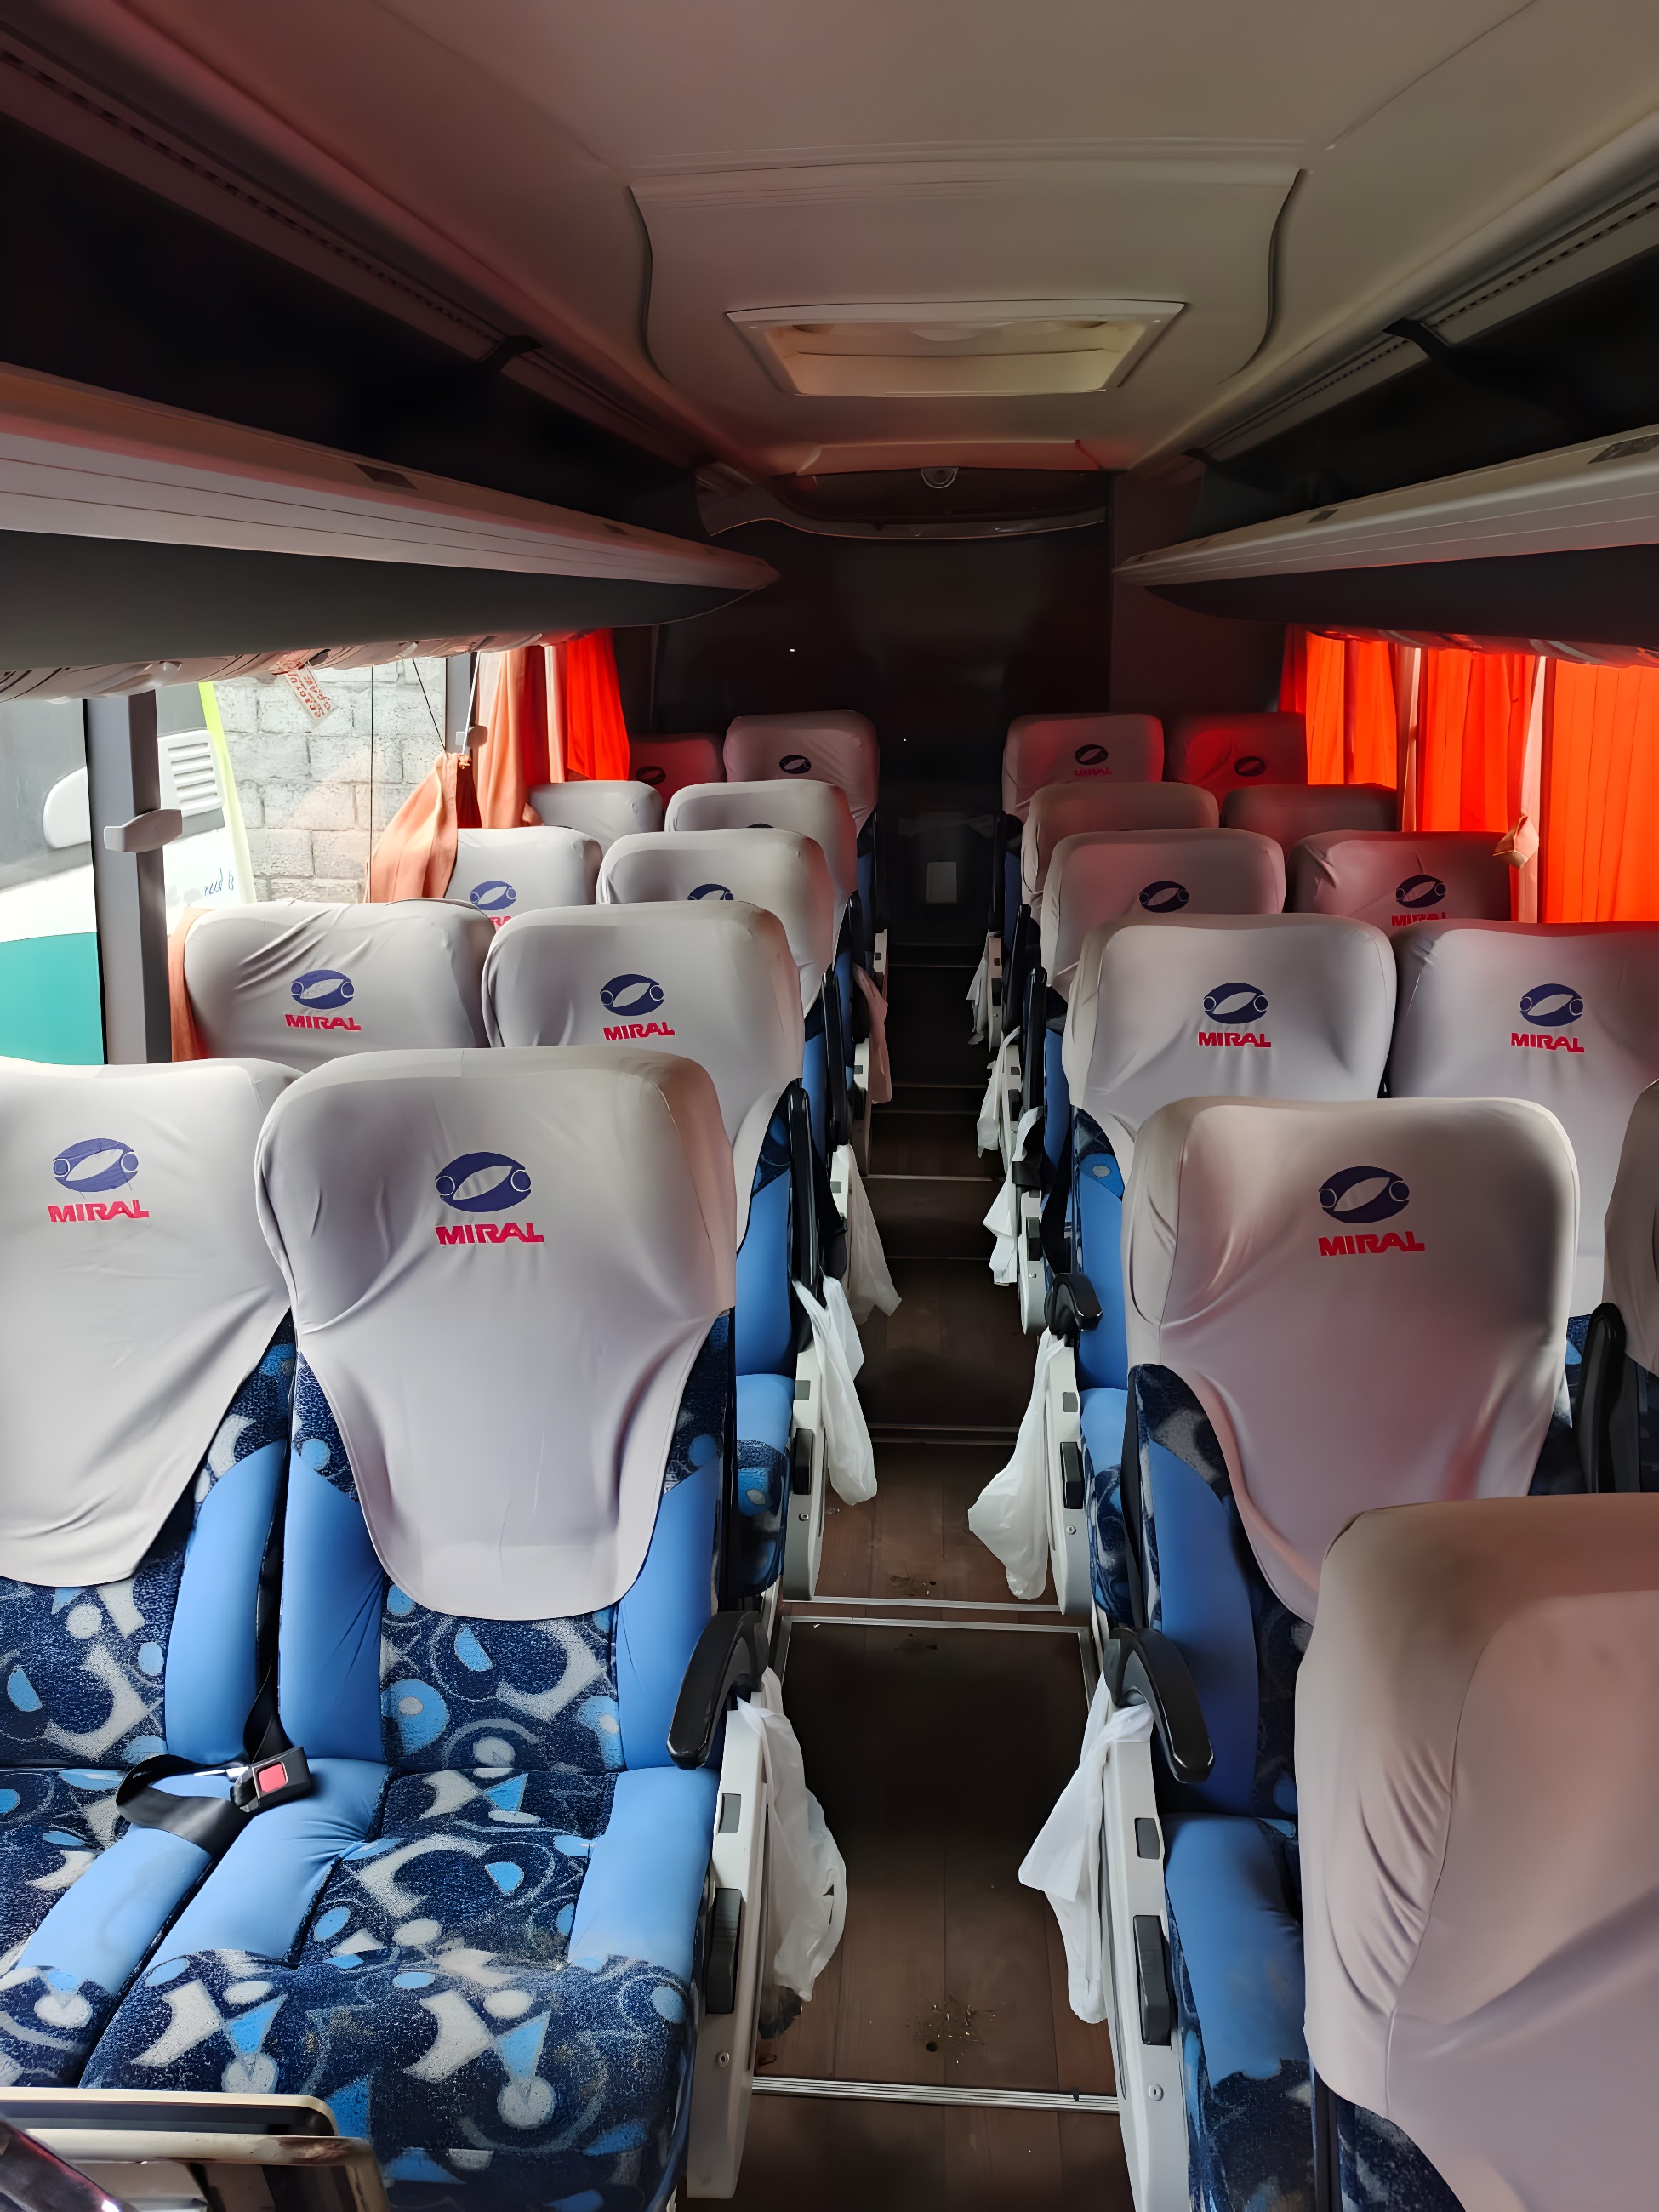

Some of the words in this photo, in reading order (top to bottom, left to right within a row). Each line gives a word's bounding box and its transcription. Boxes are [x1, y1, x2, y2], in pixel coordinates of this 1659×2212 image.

[285, 1013, 362, 1031] MIRAL
[603, 1021, 676, 1040] MIRAL
[1198, 1031, 1272, 1048] MIRAL
[1510, 1032, 1585, 1053] MIRAL
[48, 1200, 150, 1223] MIRAL
[436, 1222, 545, 1245] MIRAL
[1318, 1230, 1426, 1257] MIRAL
